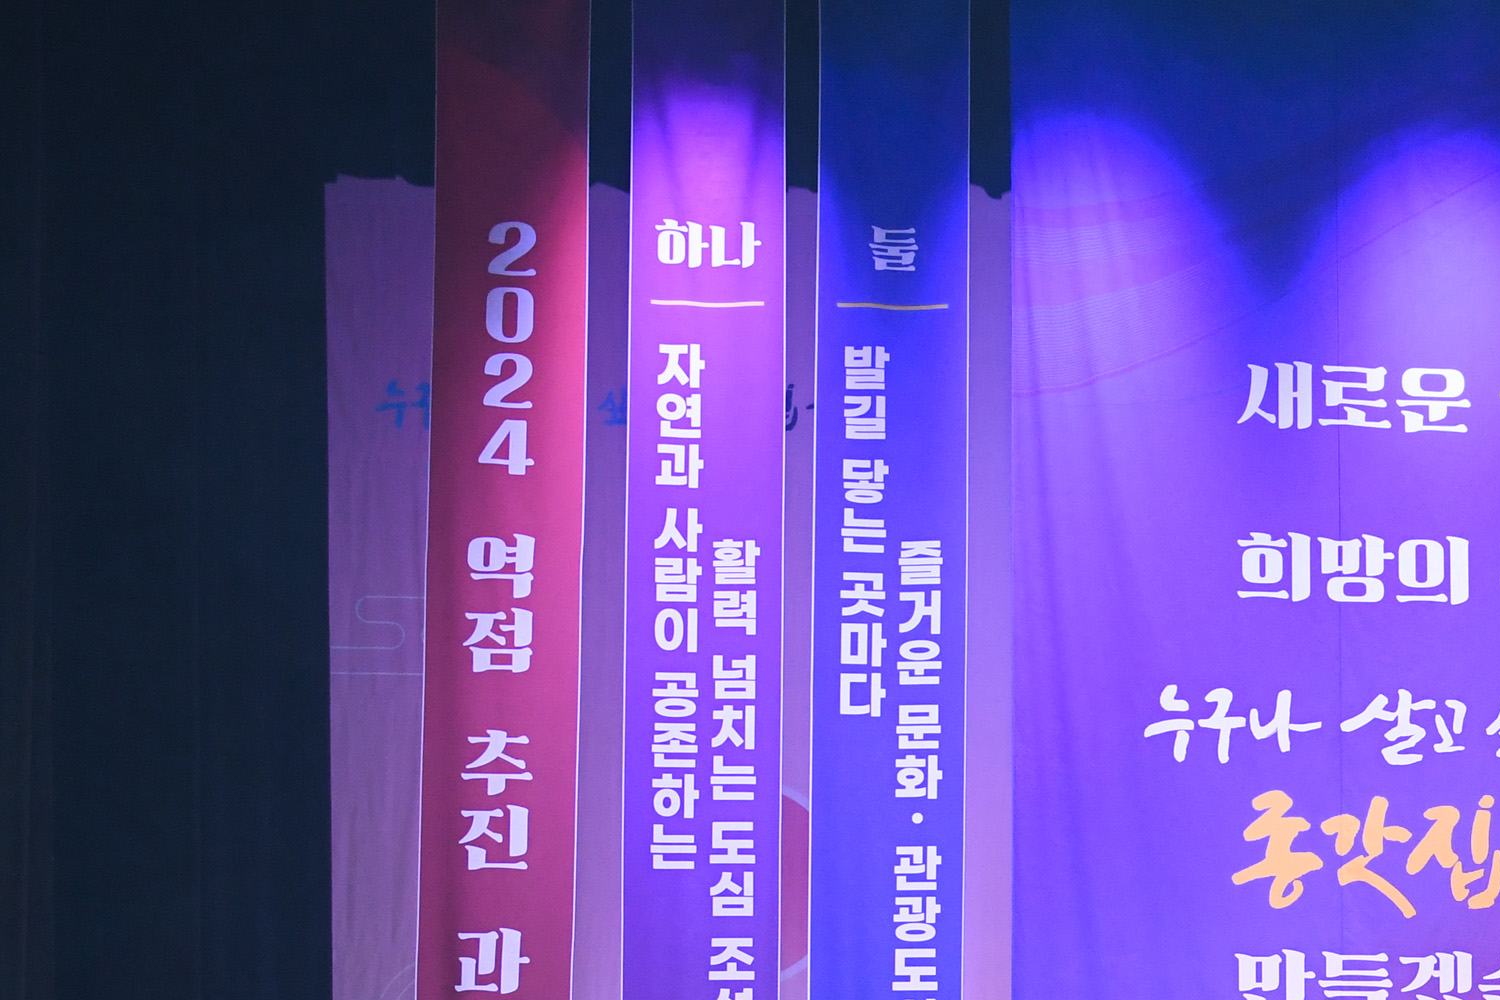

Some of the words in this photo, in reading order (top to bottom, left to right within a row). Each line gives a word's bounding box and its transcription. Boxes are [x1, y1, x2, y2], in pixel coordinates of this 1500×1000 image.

[654, 218, 762, 269] 하나
[868, 225, 919, 272] 둘
[477, 222, 537, 476] 2024
[843, 345, 890, 440] 발길
[1236, 361, 1472, 434] 새로운
[655, 343, 706, 489] 자연과
[840, 458, 890, 554] 닿는
[462, 533, 536, 674] 역점
[653, 507, 704, 655] 사람이
[711, 537, 761, 636] 활력
[896, 540, 944, 686] 즐거운
[1236, 531, 1470, 606] 희망의
[839, 571, 888, 718] 곳마다
[650, 671, 700, 870] 공존하는
[710, 654, 757, 801] 넘치는
[1143, 684, 1323, 764] 누구나
[1339, 688, 1467, 766] 살고
[458, 729, 534, 871] 추진
[709, 821, 756, 917] 도심
